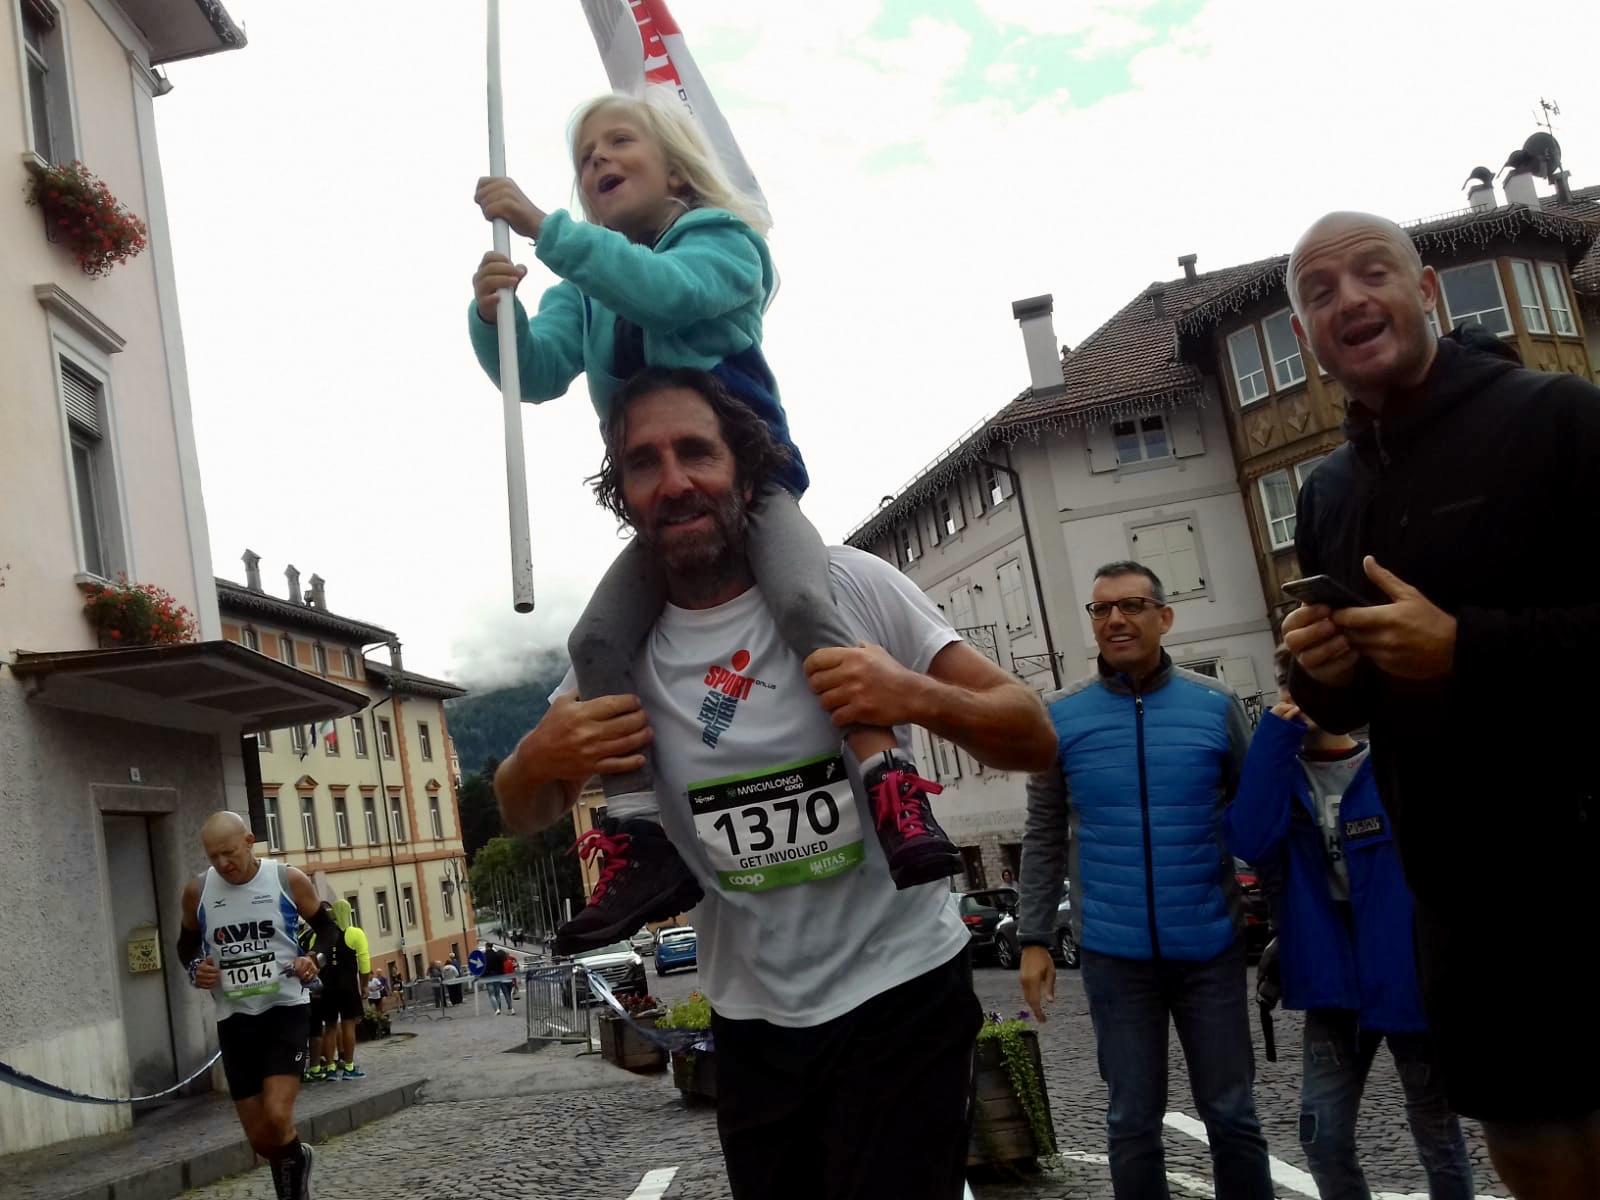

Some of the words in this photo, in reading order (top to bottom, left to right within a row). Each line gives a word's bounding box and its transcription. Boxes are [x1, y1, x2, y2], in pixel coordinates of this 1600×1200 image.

[704, 665, 756, 701] SPORT
[737, 774, 802, 796] MARCIALONGA
[713, 790, 840, 856] 1370
[740, 854, 763, 869] GET
[766, 840, 828, 865] INVOLVED
[823, 853, 845, 868] ITAS
[729, 873, 765, 886] coop
[213, 920, 275, 946] AVIS
[227, 964, 273, 985] 1014
